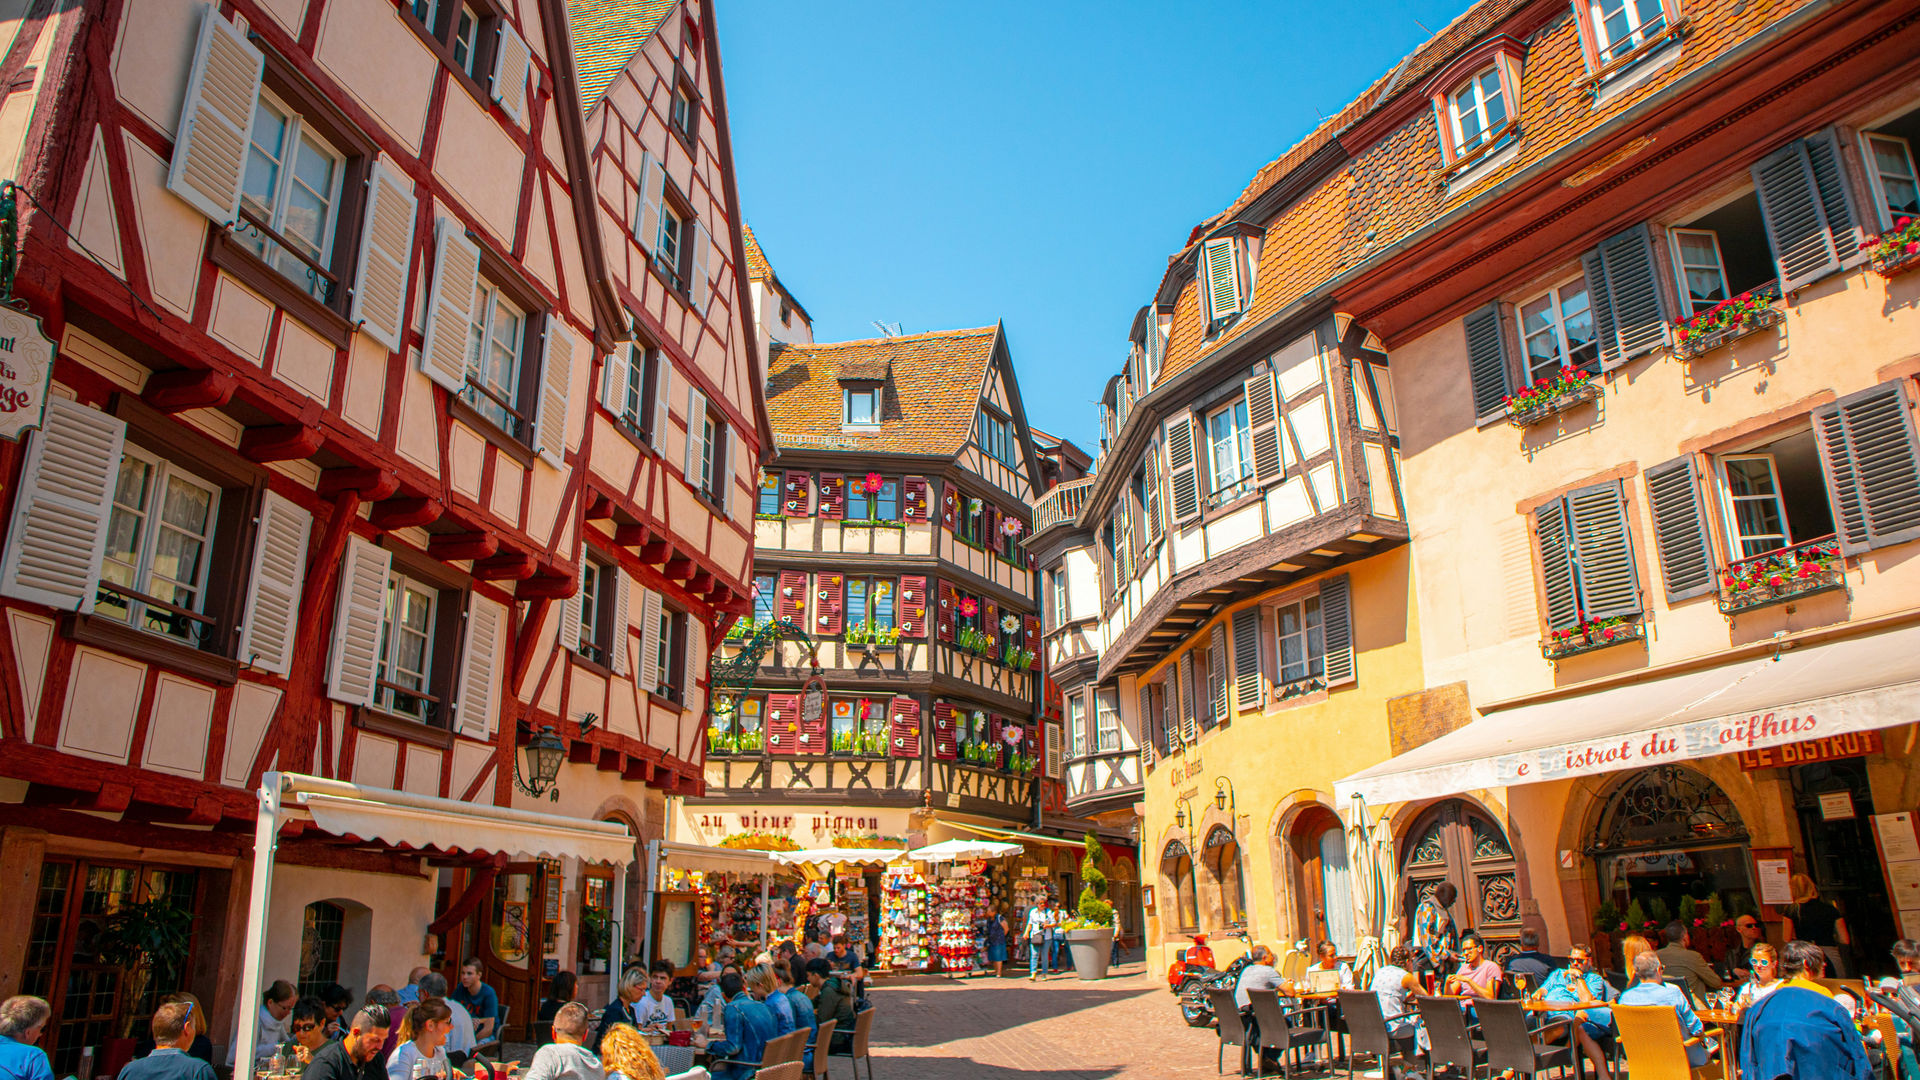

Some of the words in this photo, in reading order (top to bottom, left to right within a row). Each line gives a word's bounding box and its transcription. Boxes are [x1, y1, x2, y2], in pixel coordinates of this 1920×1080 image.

[1641, 733, 1679, 757] du
[1743, 748, 1773, 768] LE
[701, 814, 723, 828] au
[740, 810, 793, 828] vieux
[812, 811, 878, 834] pignon
